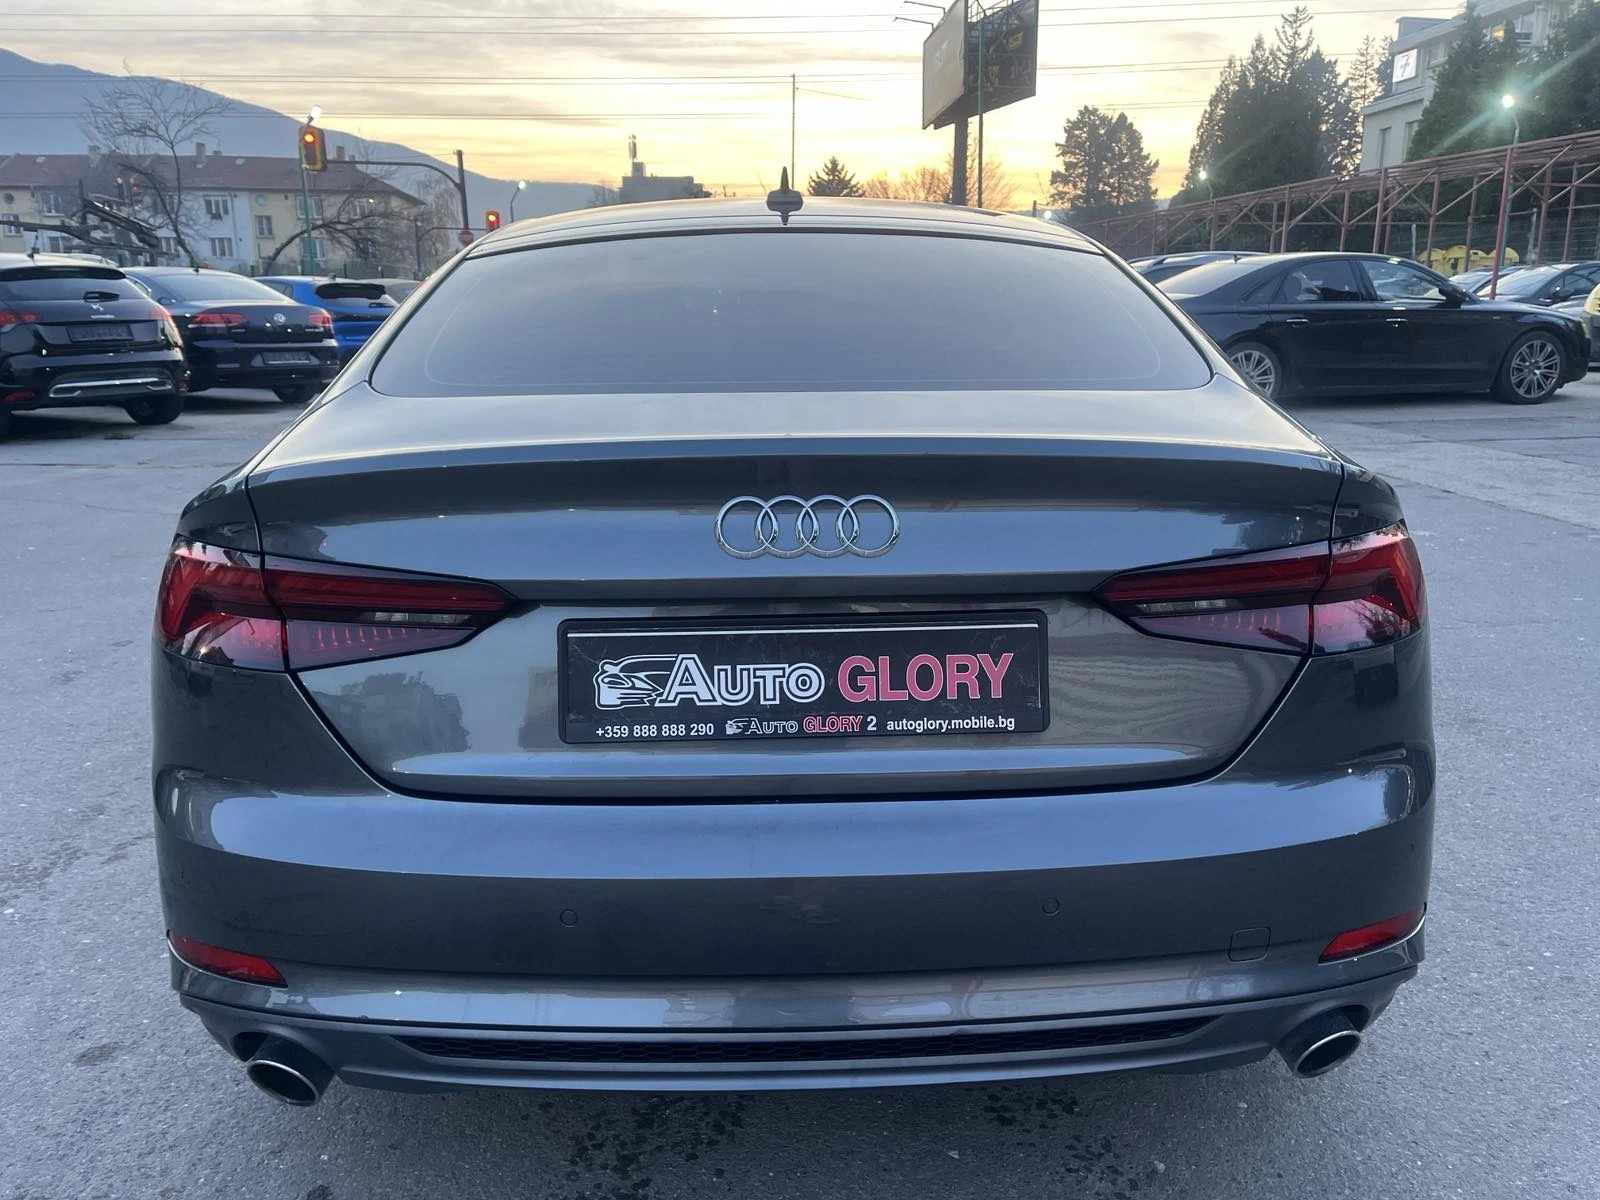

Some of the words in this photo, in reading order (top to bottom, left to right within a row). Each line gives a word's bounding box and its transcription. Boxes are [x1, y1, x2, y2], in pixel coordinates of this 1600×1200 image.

[655, 653, 825, 707] AUTO
[837, 652, 1014, 703] GLORY
[596, 725, 629, 738] +359
[633, 725, 658, 737] 888
[661, 724, 686, 736] 888
[690, 723, 715, 736] 290
[803, 715, 863, 733] GLORY
[867, 715, 877, 731] 2
[886, 715, 1015, 733] autoglory.mobile.bg
